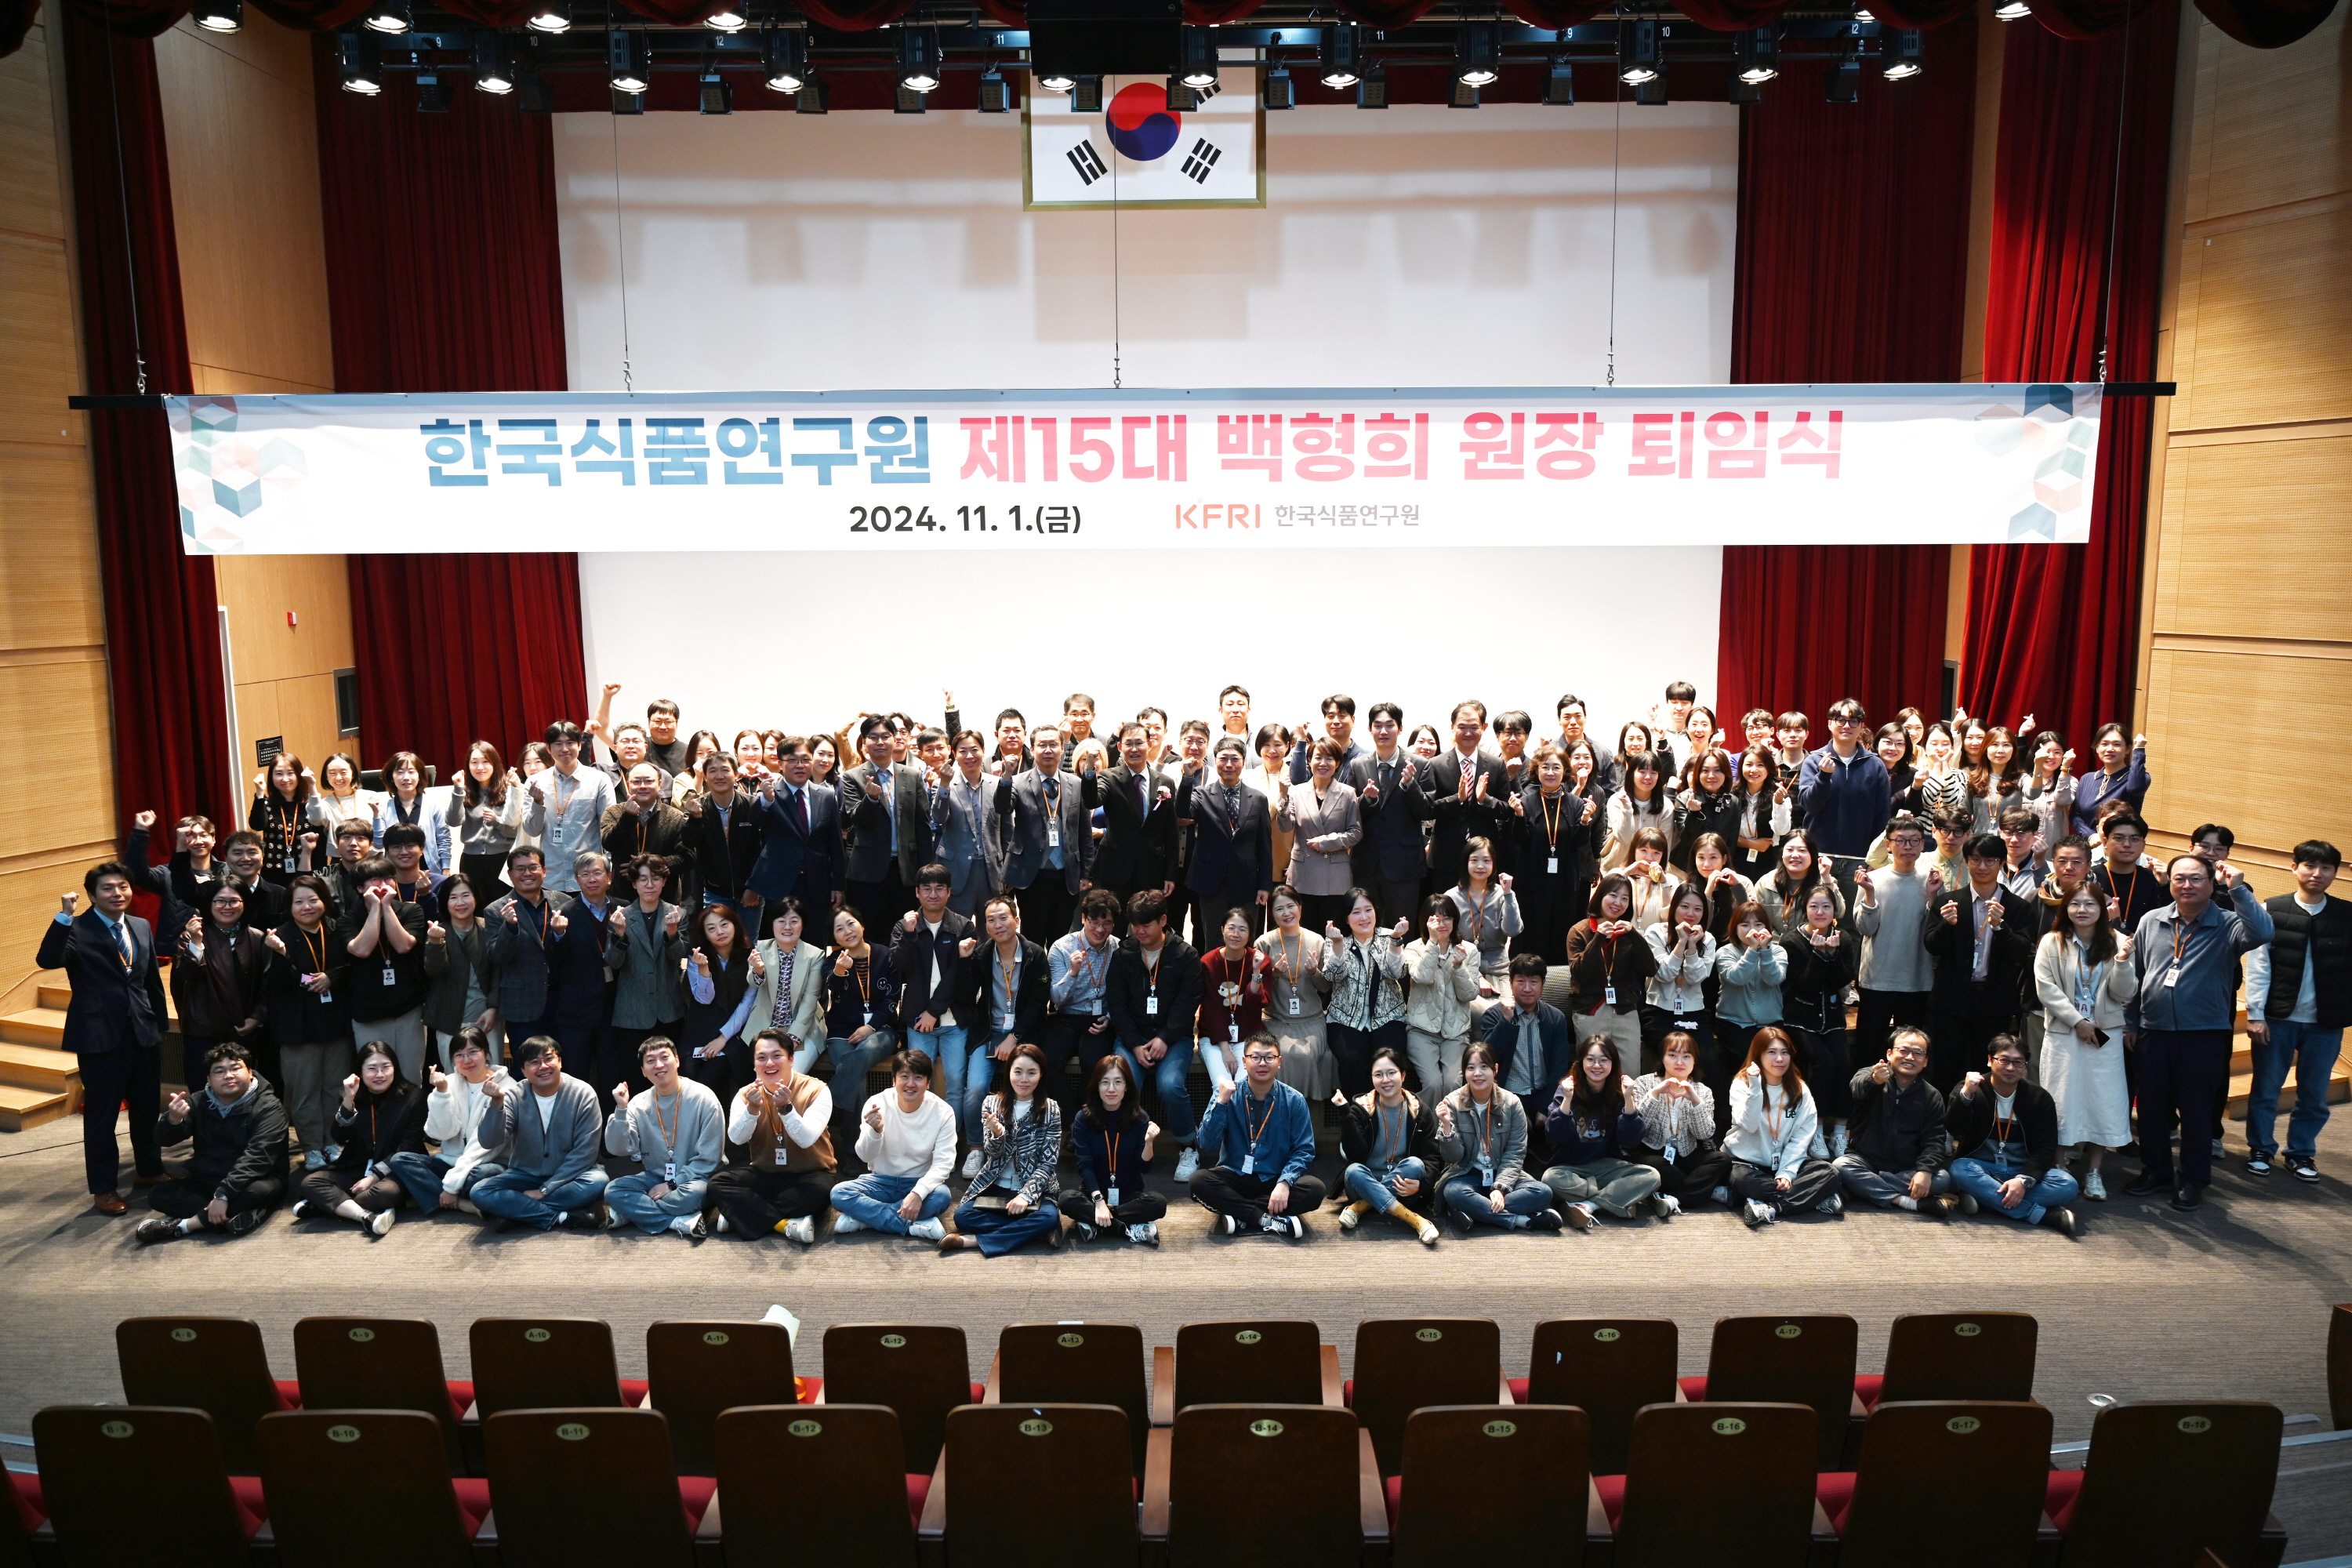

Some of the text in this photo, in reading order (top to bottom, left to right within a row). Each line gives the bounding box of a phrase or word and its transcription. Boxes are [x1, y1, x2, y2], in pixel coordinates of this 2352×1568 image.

[1376, 30, 1385, 41] 11
[1567, 28, 1573, 38] 9
[1662, 27, 1671, 38] 10
[436, 36, 442, 48] 9
[530, 35, 538, 47] 10
[715, 35, 724, 46] 12
[808, 35, 815, 47] 9
[996, 34, 1004, 45] 11
[419, 410, 1844, 487] 한국식품연구원 제15대 백형희 원장 퇴임식
[849, 505, 1082, 534] 2024. 11. 1.(금)
[1176, 503, 1261, 529] KFRI
[1275, 504, 1419, 527] 한국식품연구원
[1488, 1425, 1511, 1433] B-15
[1951, 1421, 1975, 1429] B-17
